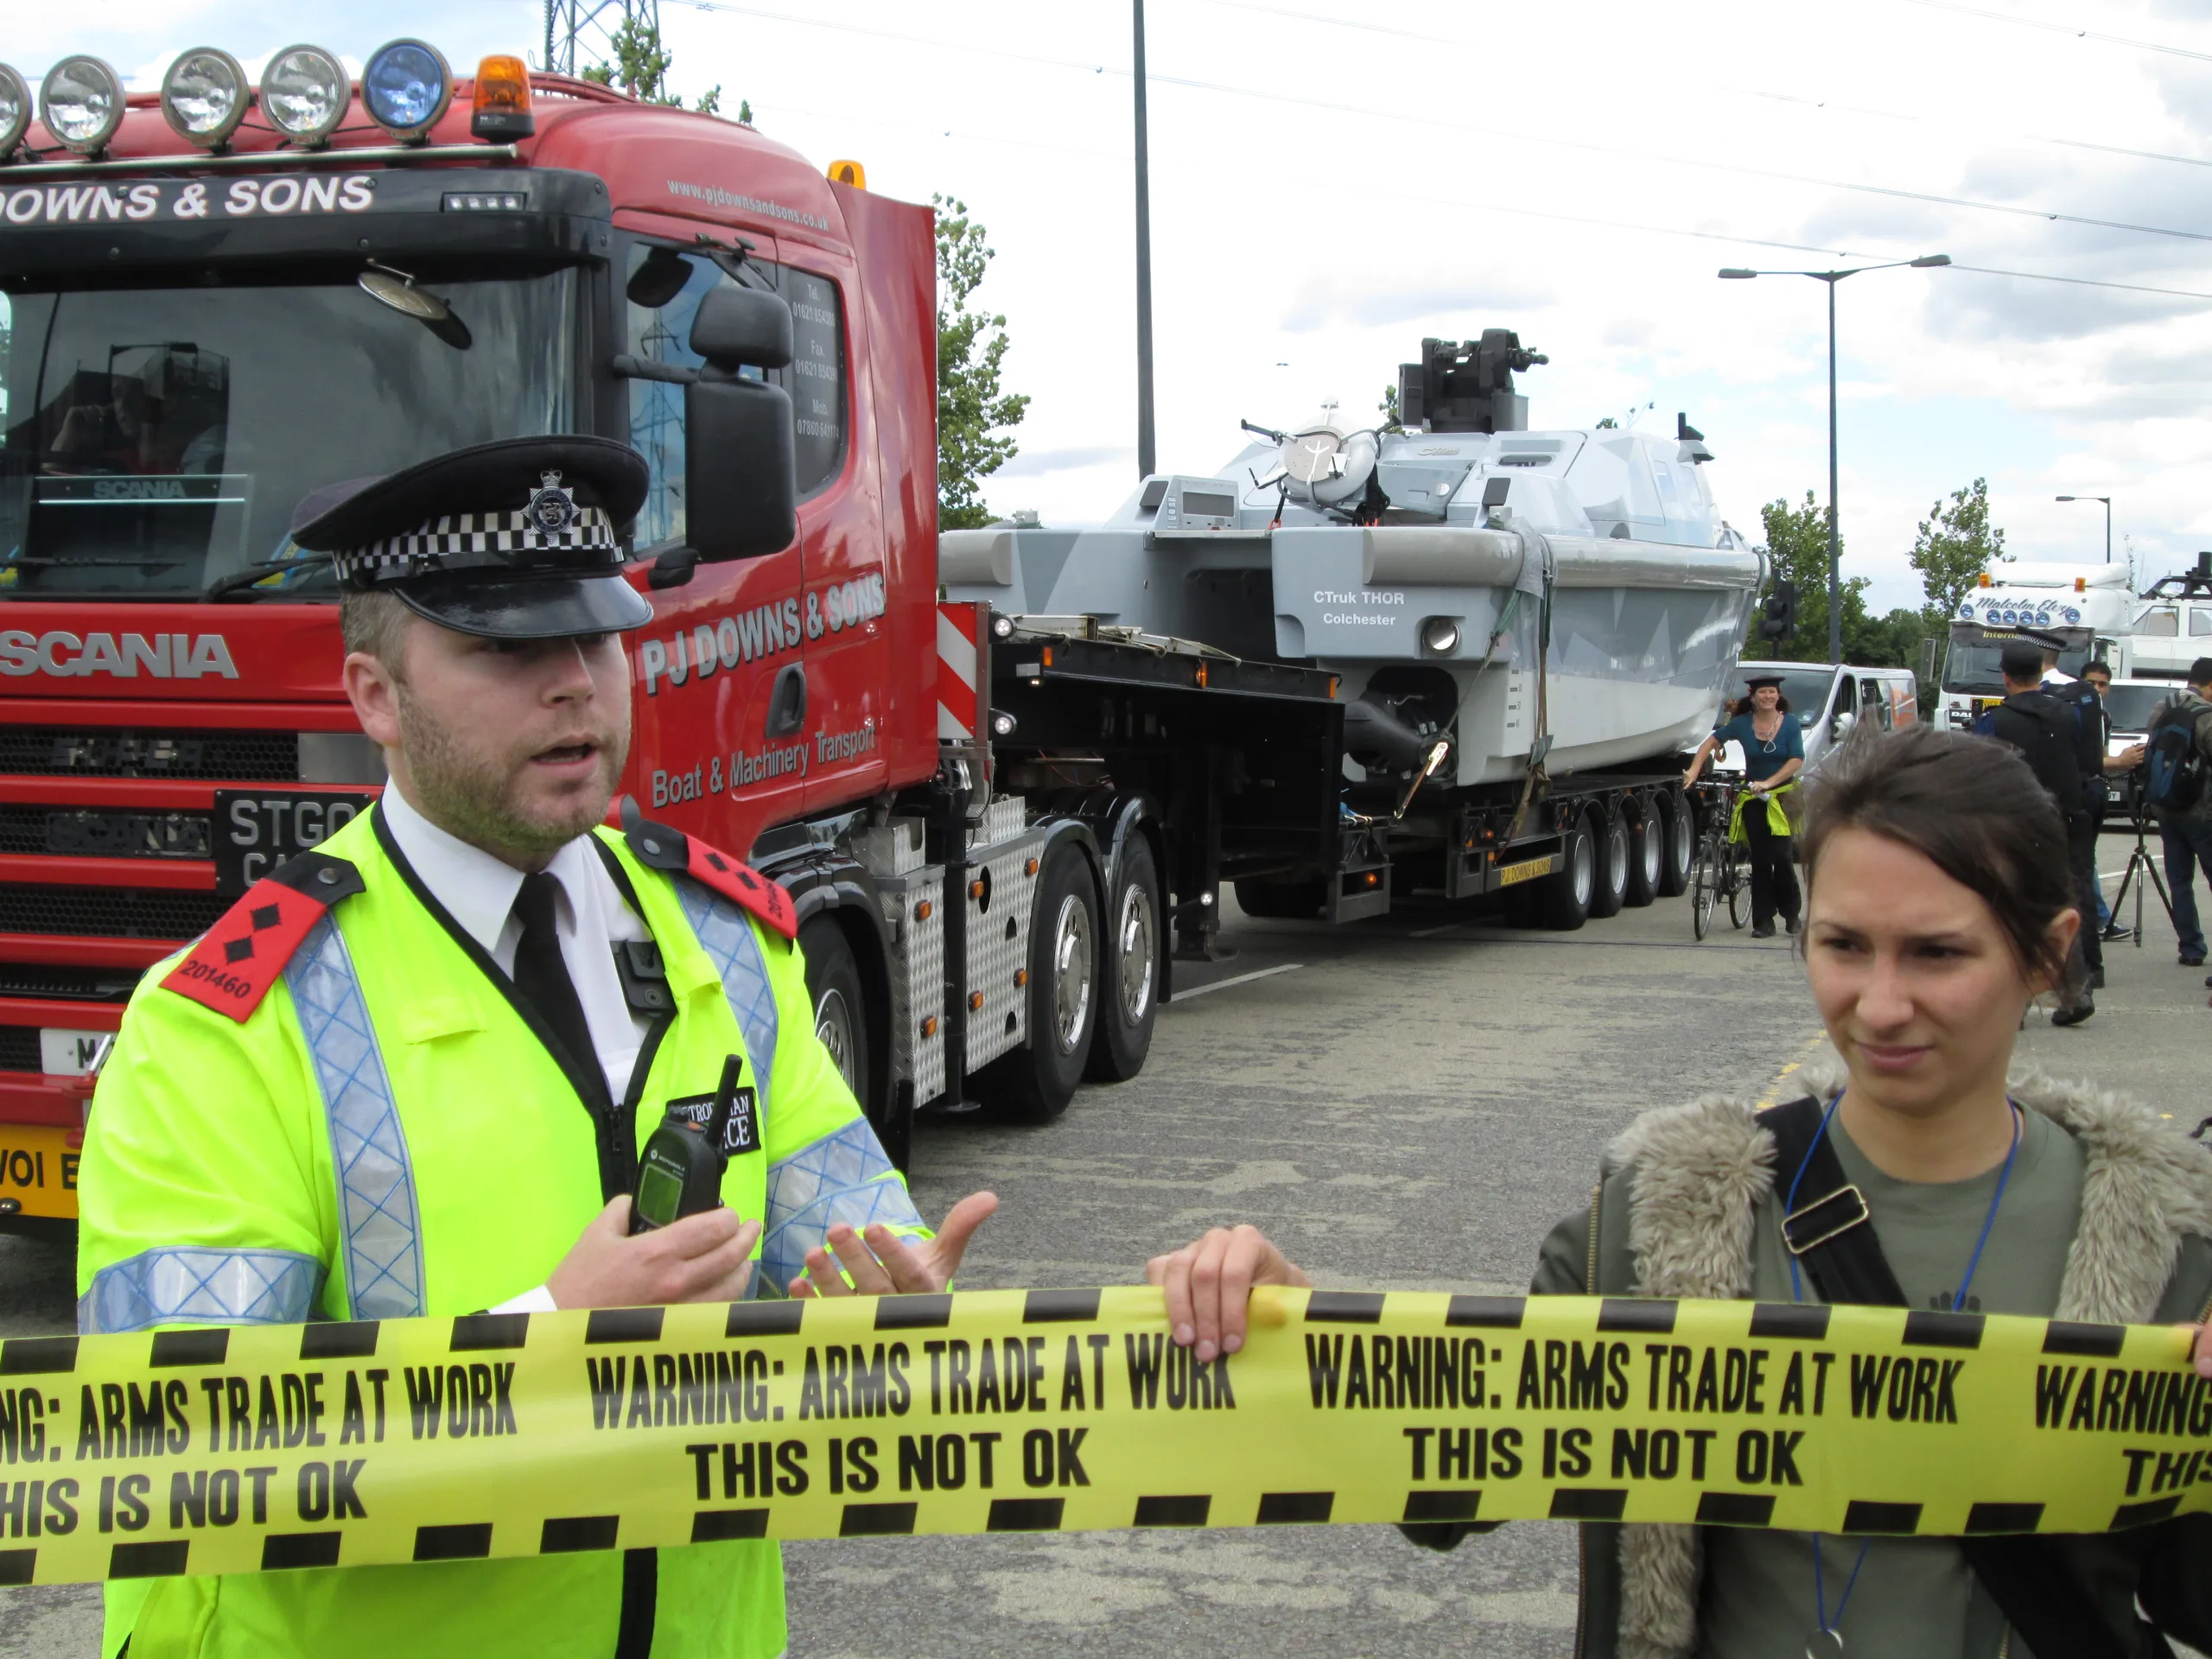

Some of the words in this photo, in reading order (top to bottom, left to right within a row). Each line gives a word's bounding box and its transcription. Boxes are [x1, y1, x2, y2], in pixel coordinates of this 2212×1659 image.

[0, 183, 160, 223] OWNS
[173, 182, 209, 218] &
[224, 175, 373, 215] SONS
[666, 179, 830, 232] www.pjdownsandsons.co.uk
[806, 283, 820, 302] Tel.
[93, 480, 187, 499] SCANIA
[1313, 591, 1357, 604] CTruk
[1361, 591, 1405, 605] THOR
[1323, 613, 1396, 626] Colchester
[1975, 597, 2035, 610] Malcolm
[0, 630, 239, 679] SCANIA
[641, 631, 690, 697] PJ
[694, 597, 803, 680] DOWNS
[806, 591, 825, 641] &
[827, 571, 887, 632] SONS
[1983, 631, 2020, 639] Interna
[652, 760, 703, 809] Boat
[709, 757, 725, 795] &
[729, 741, 810, 790] Machinery
[815, 723, 876, 765] Transport
[180, 960, 251, 999] 201460
[586, 1349, 785, 1430] WARNING:
[798, 1340, 911, 1421] ARMS
[924, 1335, 1046, 1416] TRADE
[1060, 1333, 1109, 1412] AT
[1124, 1332, 1237, 1411] WORK
[1305, 1333, 1502, 1410] WARNING:
[1516, 1339, 1630, 1411] ARMS
[1645, 1344, 1770, 1415] TRADE
[1778, 1351, 1835, 1417] AT
[1850, 1352, 1966, 1426] WORK
[76, 1380, 190, 1460] ARMS
[201, 1372, 326, 1453] TRADE
[340, 1369, 390, 1446] AT
[404, 1362, 518, 1440] WORK
[685, 1439, 810, 1500] THIS
[829, 1436, 879, 1495] IS
[899, 1431, 1001, 1491] NOT
[1023, 1427, 1090, 1488] OK
[1402, 1427, 1522, 1482] THIS
[1541, 1428, 1592, 1480] IS
[1611, 1429, 1717, 1482] NOT
[1736, 1429, 1807, 1485] OK
[0, 1478, 79, 1539] HIS
[99, 1473, 150, 1535] IS
[169, 1466, 277, 1530] NOT
[297, 1458, 368, 1523] OK
